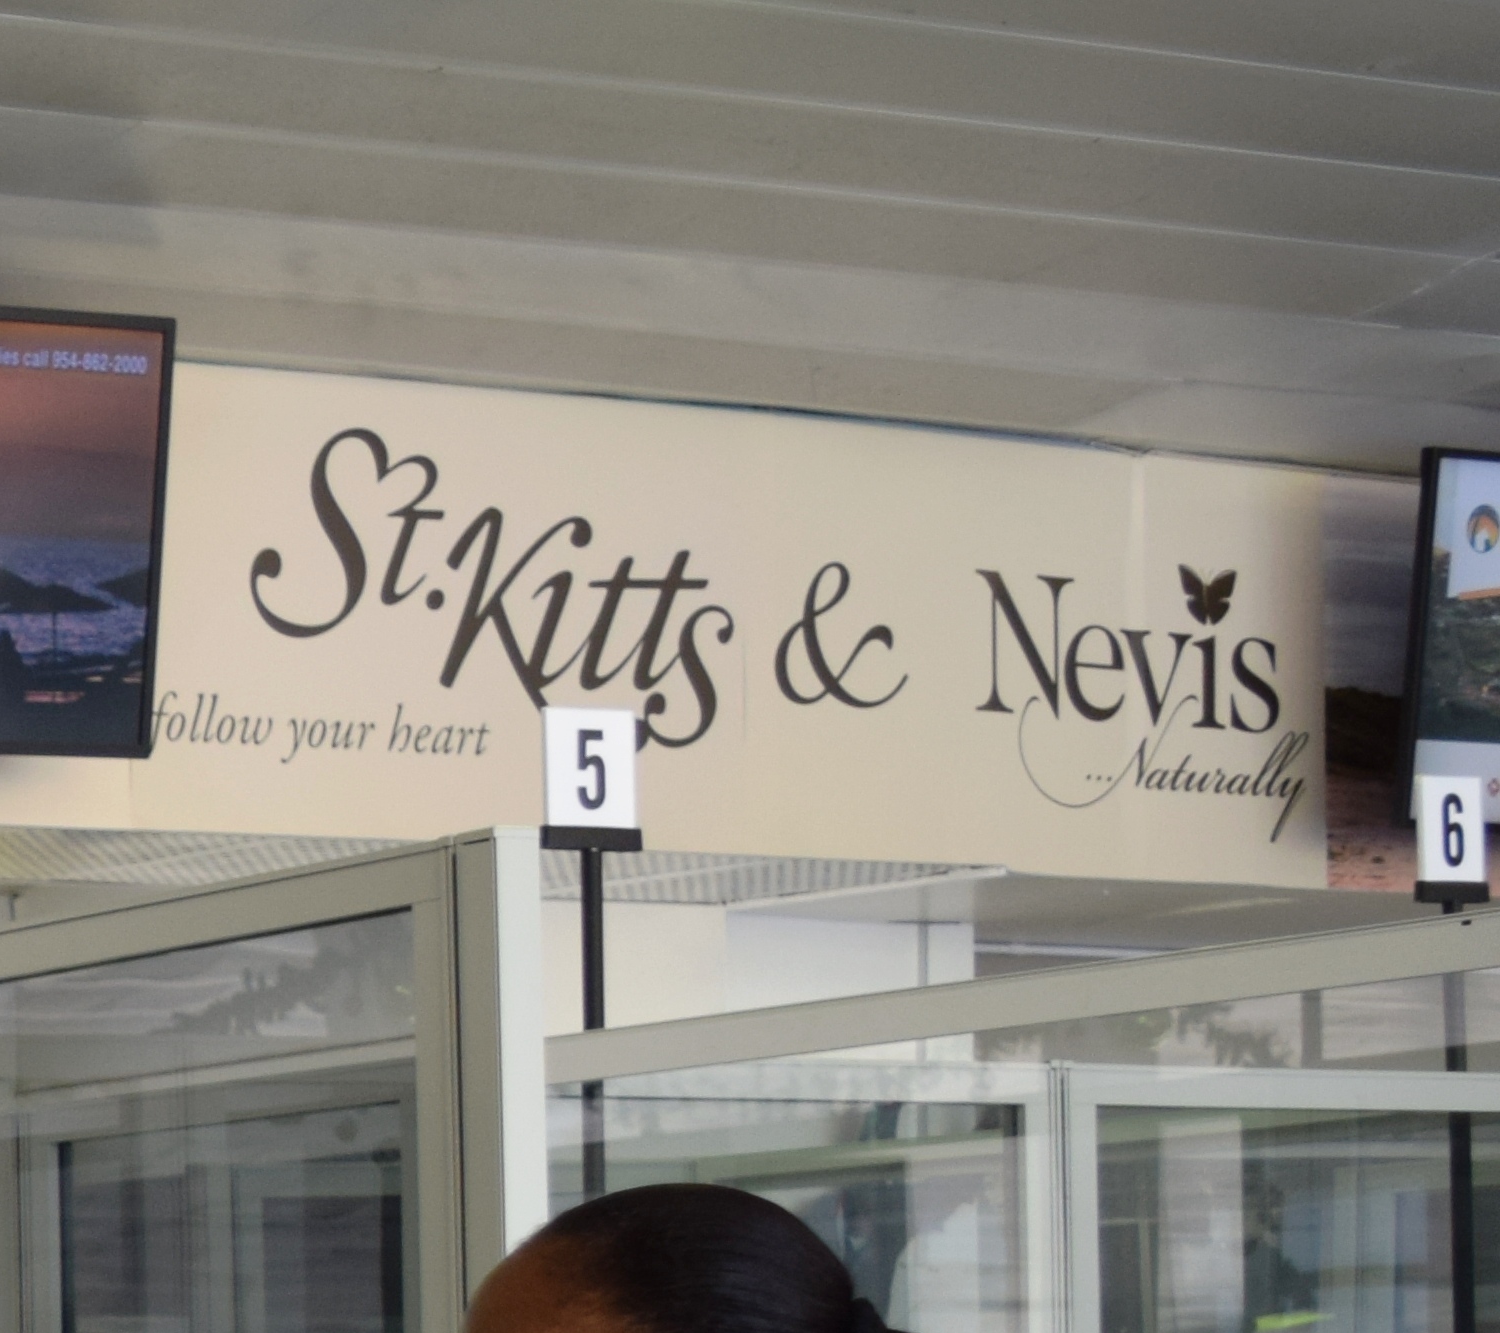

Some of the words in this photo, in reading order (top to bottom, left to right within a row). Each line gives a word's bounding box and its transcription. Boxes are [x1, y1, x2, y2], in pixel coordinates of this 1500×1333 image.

[23, 349, 49, 368] call
[775, 562, 908, 708] &
[974, 565, 1280, 733] Nevis
[151, 691, 273, 756] follow
[281, 717, 376, 764] your
[388, 703, 491, 756] heart
[575, 729, 607, 810] 5
[1441, 793, 1465, 867] 6
